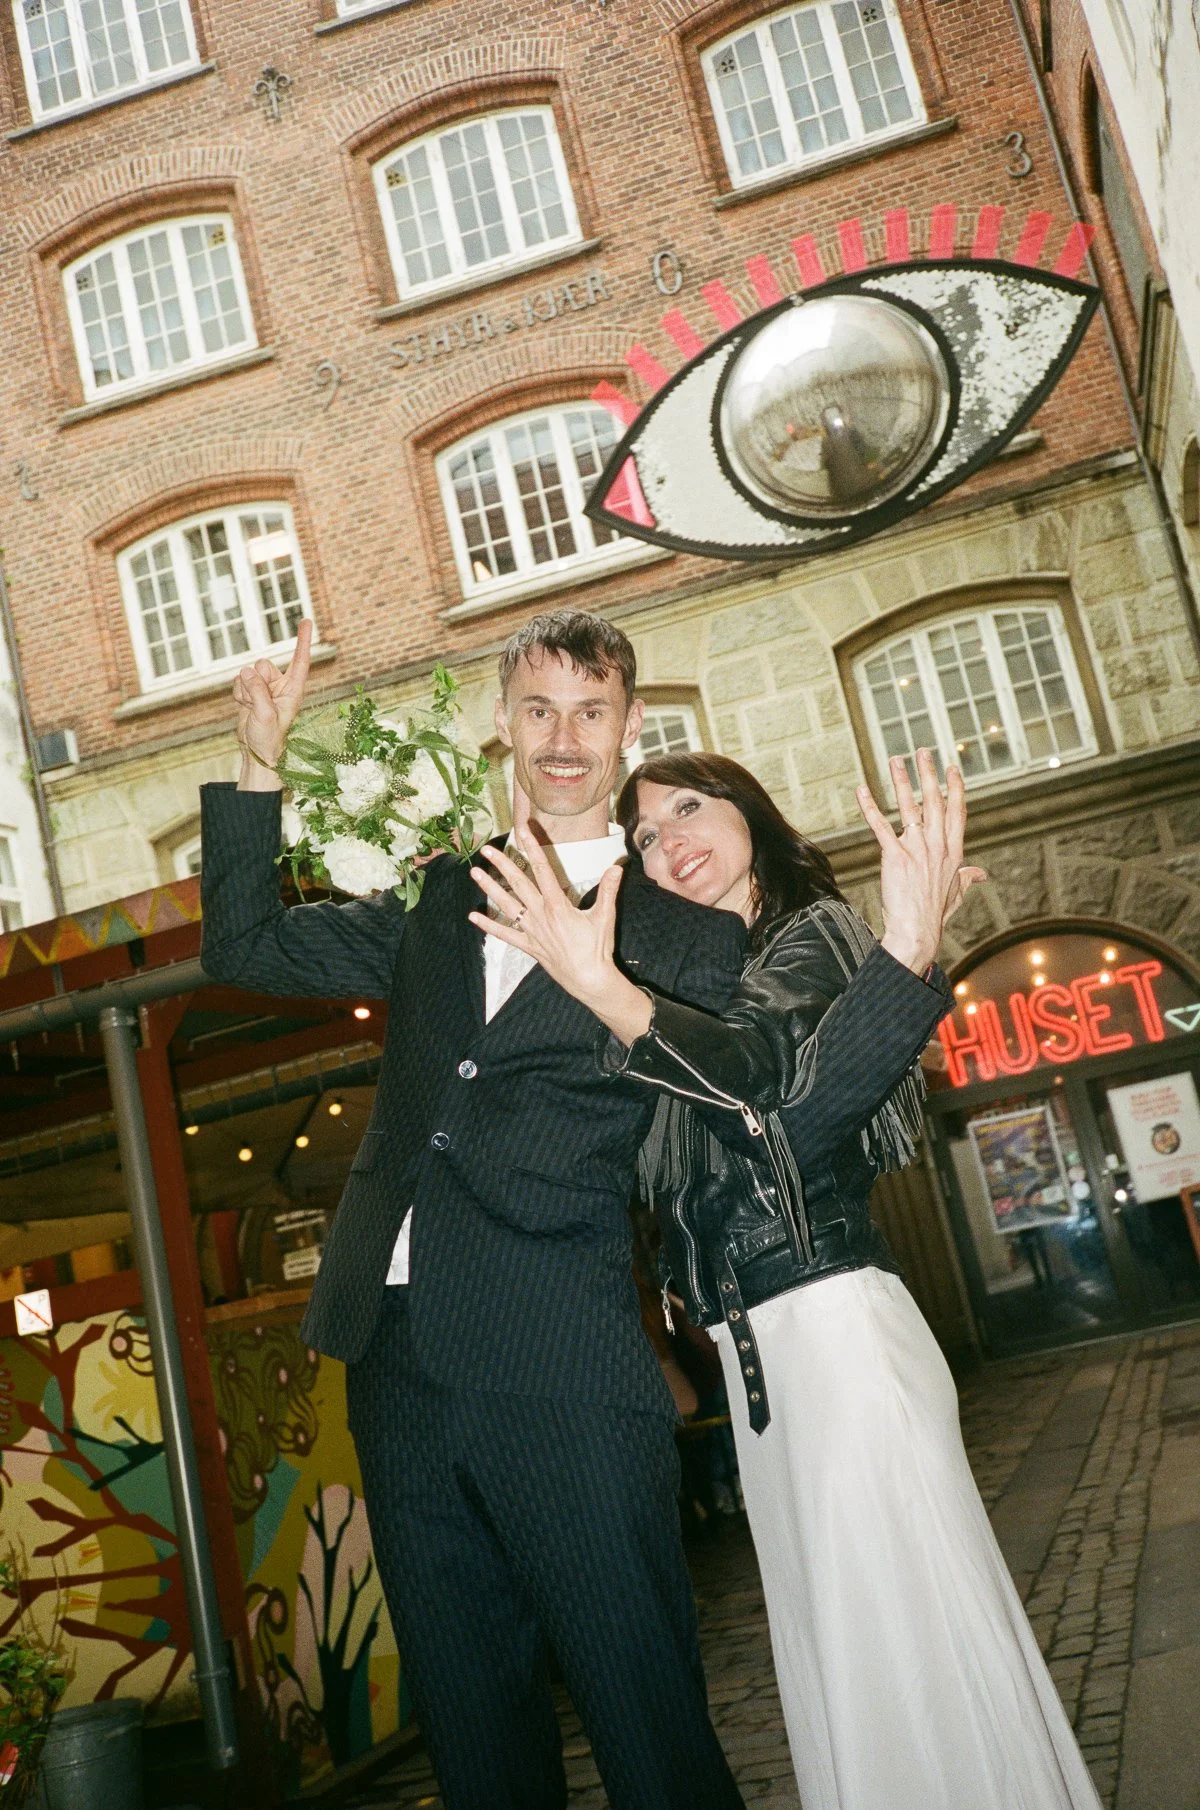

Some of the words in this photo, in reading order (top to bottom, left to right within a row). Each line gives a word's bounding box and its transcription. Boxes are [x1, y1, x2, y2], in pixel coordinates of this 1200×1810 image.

[314, 361, 341, 412] 9
[1003, 130, 1033, 178] 3
[938, 961, 1165, 1087] HUSET
